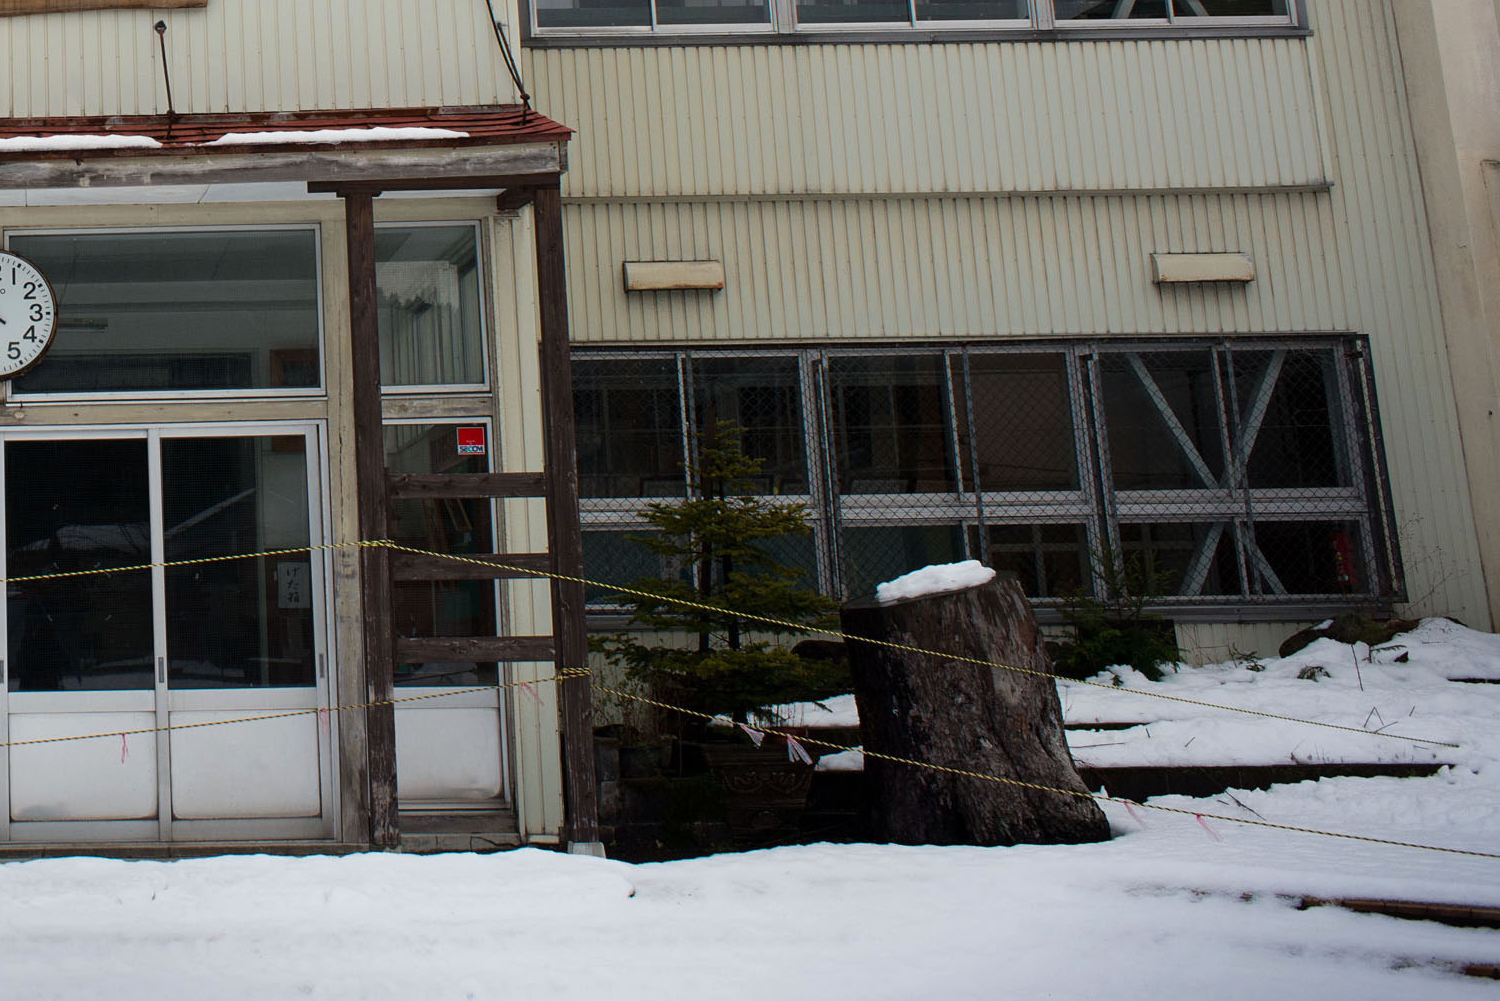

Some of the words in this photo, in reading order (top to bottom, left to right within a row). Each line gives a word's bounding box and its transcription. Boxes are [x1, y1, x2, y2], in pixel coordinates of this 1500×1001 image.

[12, 267, 16, 285] 1
[23, 282, 37, 299] 2
[29, 304, 43, 322] 3
[23, 325, 37, 343] 4
[7, 342, 21, 360] 5
